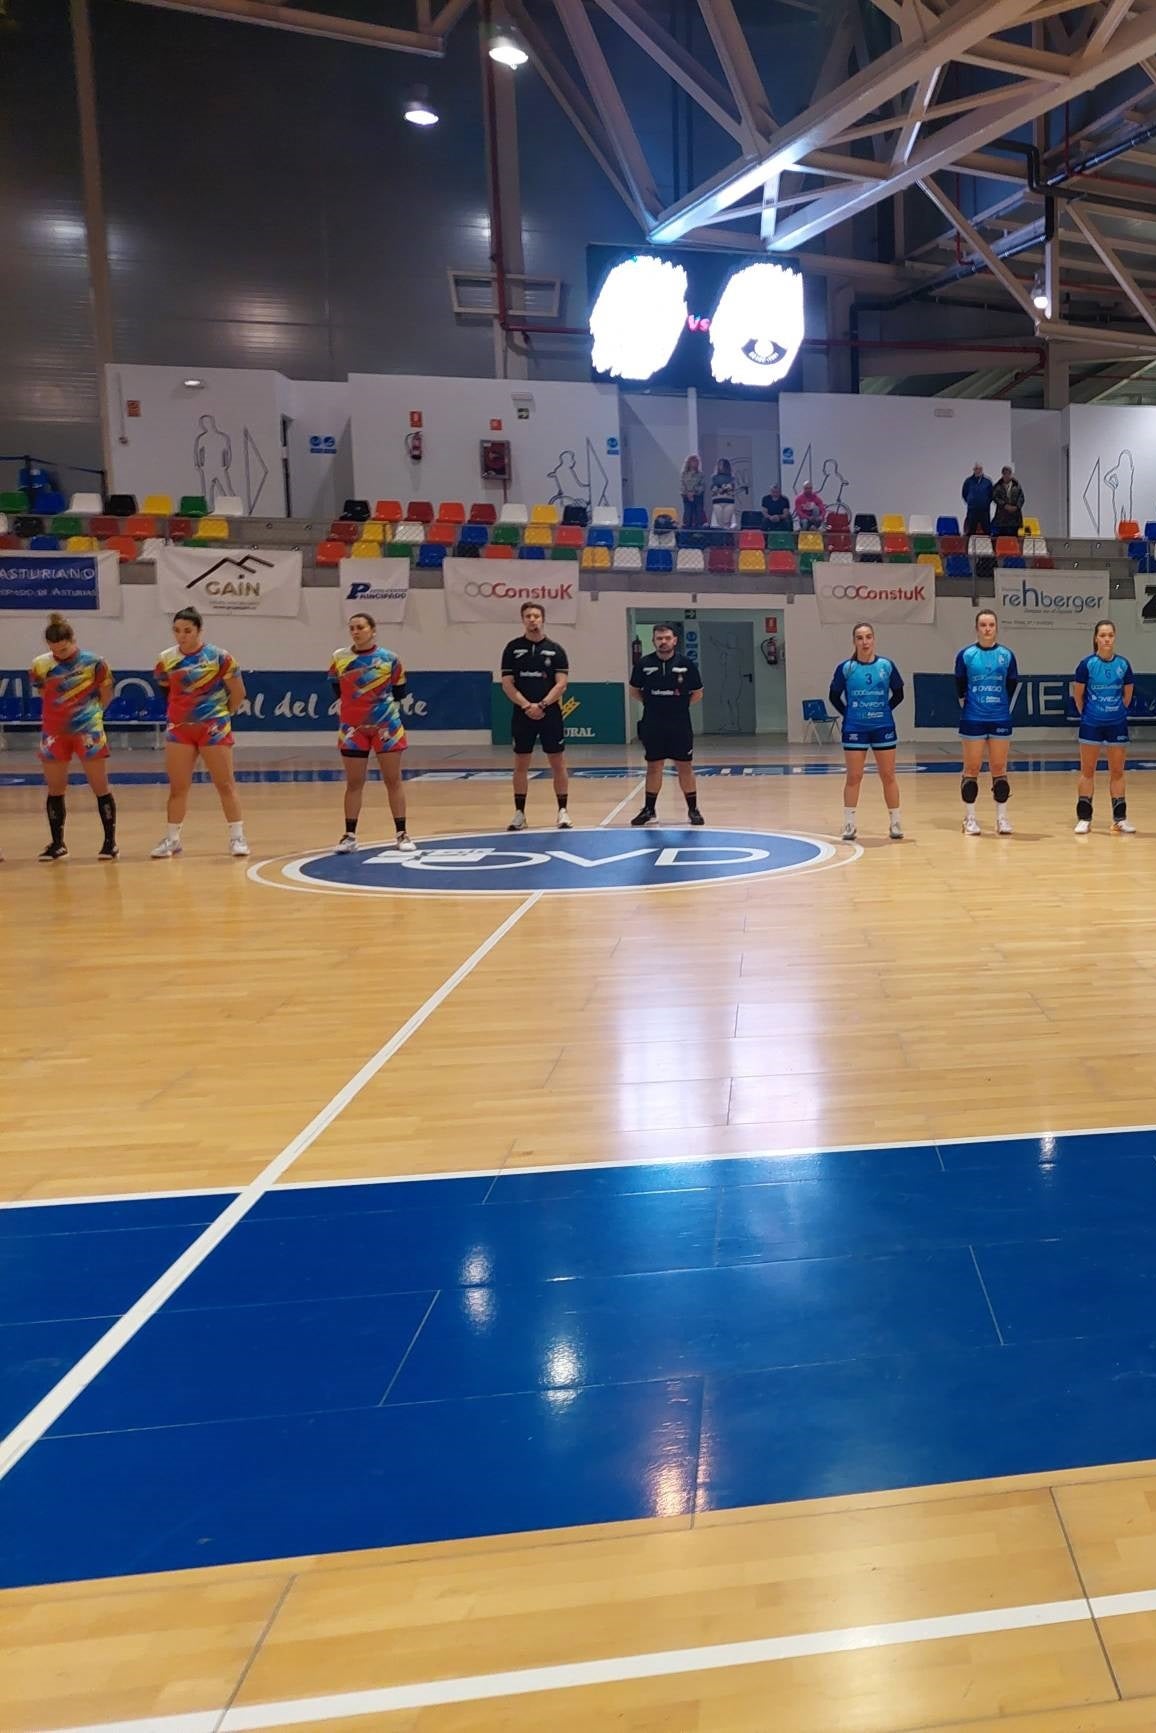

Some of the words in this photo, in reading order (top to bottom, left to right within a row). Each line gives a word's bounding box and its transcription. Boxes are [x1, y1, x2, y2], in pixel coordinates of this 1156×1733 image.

[0, 568, 95, 580] ASTURIANO
[864, 673, 873, 685] 3
[274, 692, 319, 719] del
[563, 727, 596, 738] URAL
